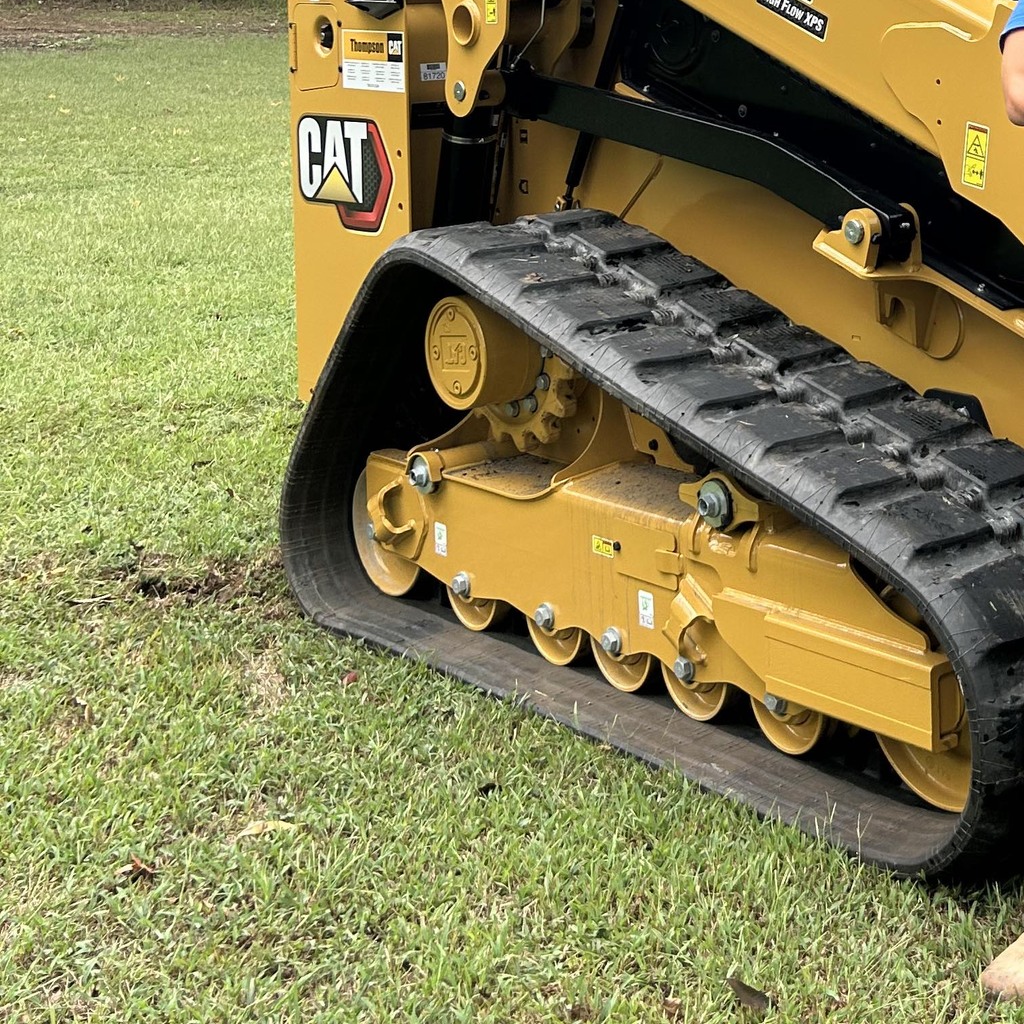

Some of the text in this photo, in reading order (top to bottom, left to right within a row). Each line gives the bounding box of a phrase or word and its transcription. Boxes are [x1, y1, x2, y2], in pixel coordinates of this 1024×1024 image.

[803, 11, 824, 32] XPS
[350, 38, 402, 55] Thompson CAT
[298, 117, 368, 204] CAT
